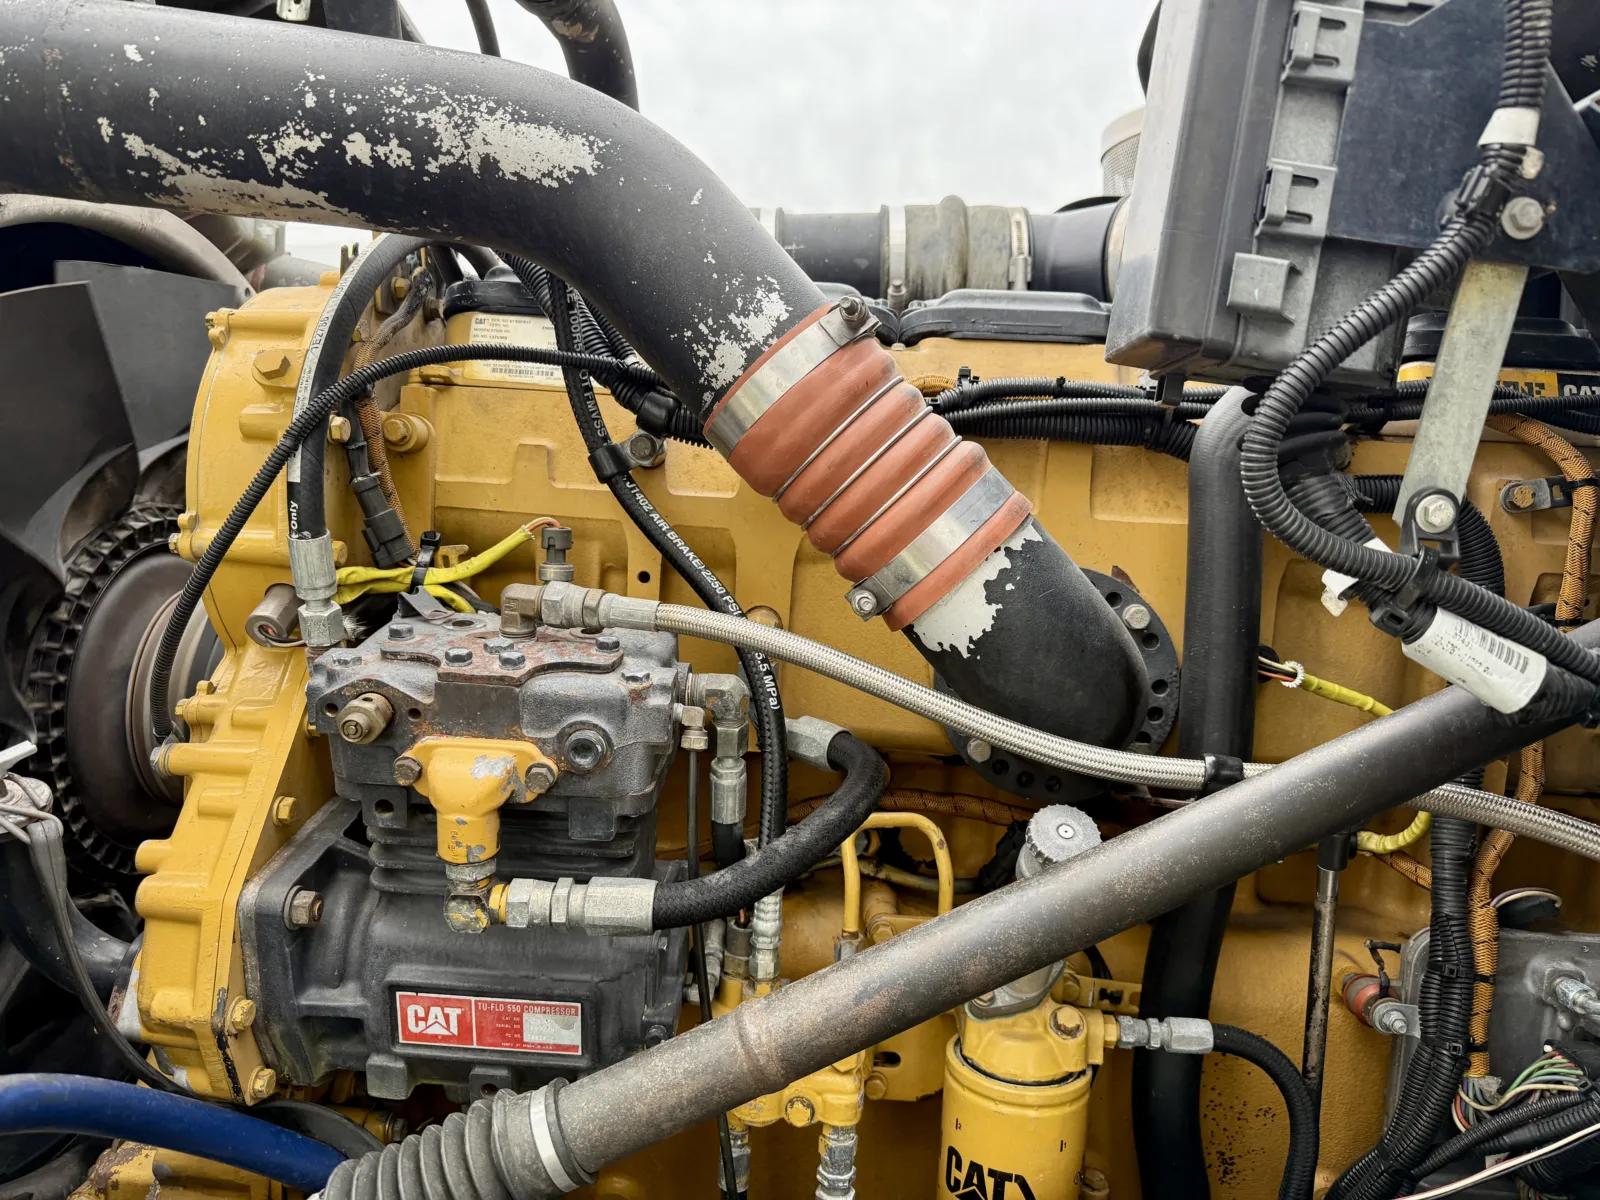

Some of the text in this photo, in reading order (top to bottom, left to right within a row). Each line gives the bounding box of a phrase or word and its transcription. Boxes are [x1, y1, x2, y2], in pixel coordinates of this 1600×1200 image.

[584, 393, 608, 438] FMVSS
[290, 500, 299, 530] Only
[625, 480, 654, 513] J1402
[649, 511, 670, 532] AIR
[666, 530, 706, 570] BRAKE)
[701, 568, 727, 595] 2250
[722, 594, 743, 617] PSI
[762, 674, 781, 710] MPa)
[406, 1003, 462, 1037] CAT
[477, 1001, 577, 1017] TU-FLO 550 COMPRESSOR
[945, 1144, 1014, 1200] CAT
